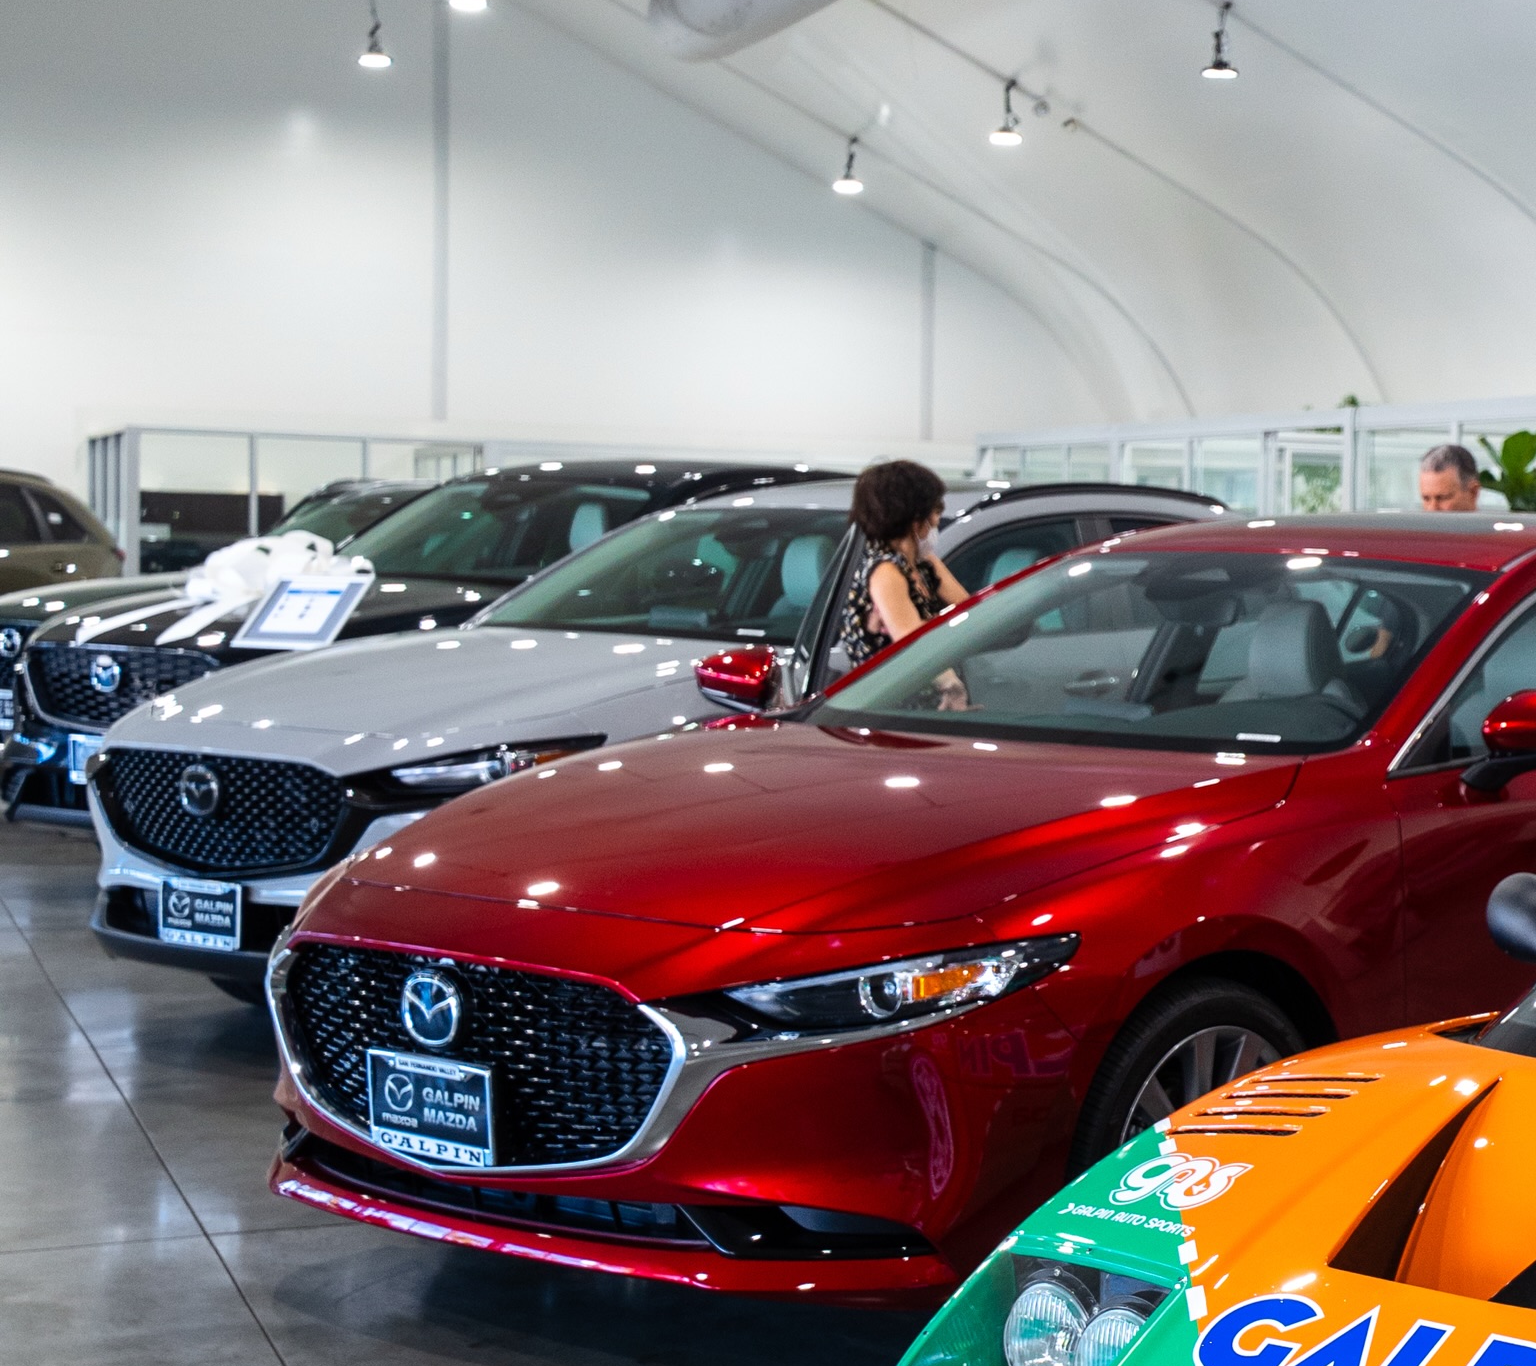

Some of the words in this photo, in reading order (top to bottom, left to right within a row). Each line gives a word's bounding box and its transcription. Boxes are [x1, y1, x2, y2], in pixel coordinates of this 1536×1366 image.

[422, 1086, 481, 1112] GALPIN
[422, 1107, 478, 1132] MAZDA
[1072, 1204, 1114, 1221] GALPIN
[1111, 1211, 1147, 1226] AUTO
[1144, 1217, 1196, 1238] SPORTS
